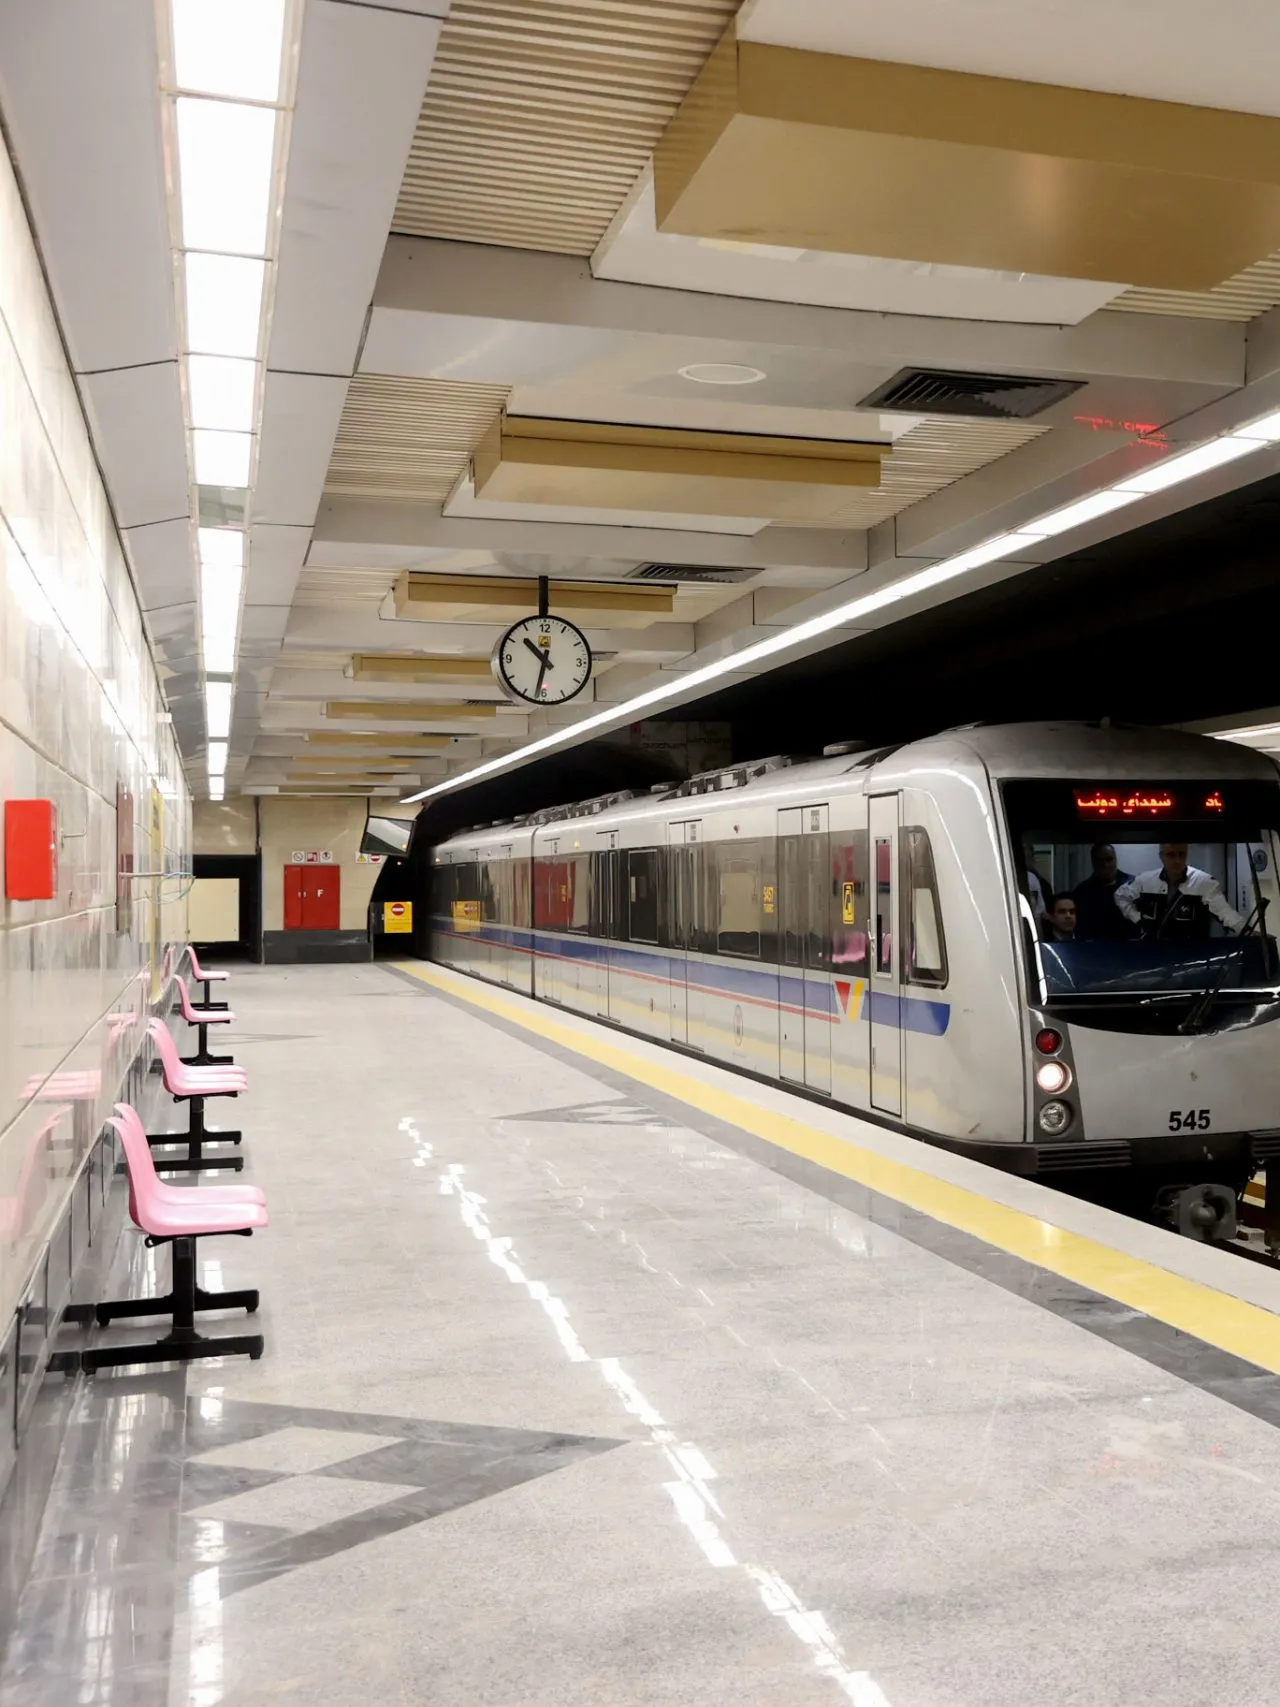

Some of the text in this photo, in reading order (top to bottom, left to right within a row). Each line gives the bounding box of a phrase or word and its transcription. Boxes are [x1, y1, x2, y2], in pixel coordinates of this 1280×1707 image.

[539, 624, 551, 633] 12
[505, 654, 513, 664] 9
[575, 658, 583, 667] 3
[540, 688, 548, 698] 6
[1168, 1109, 1211, 1131] 545
